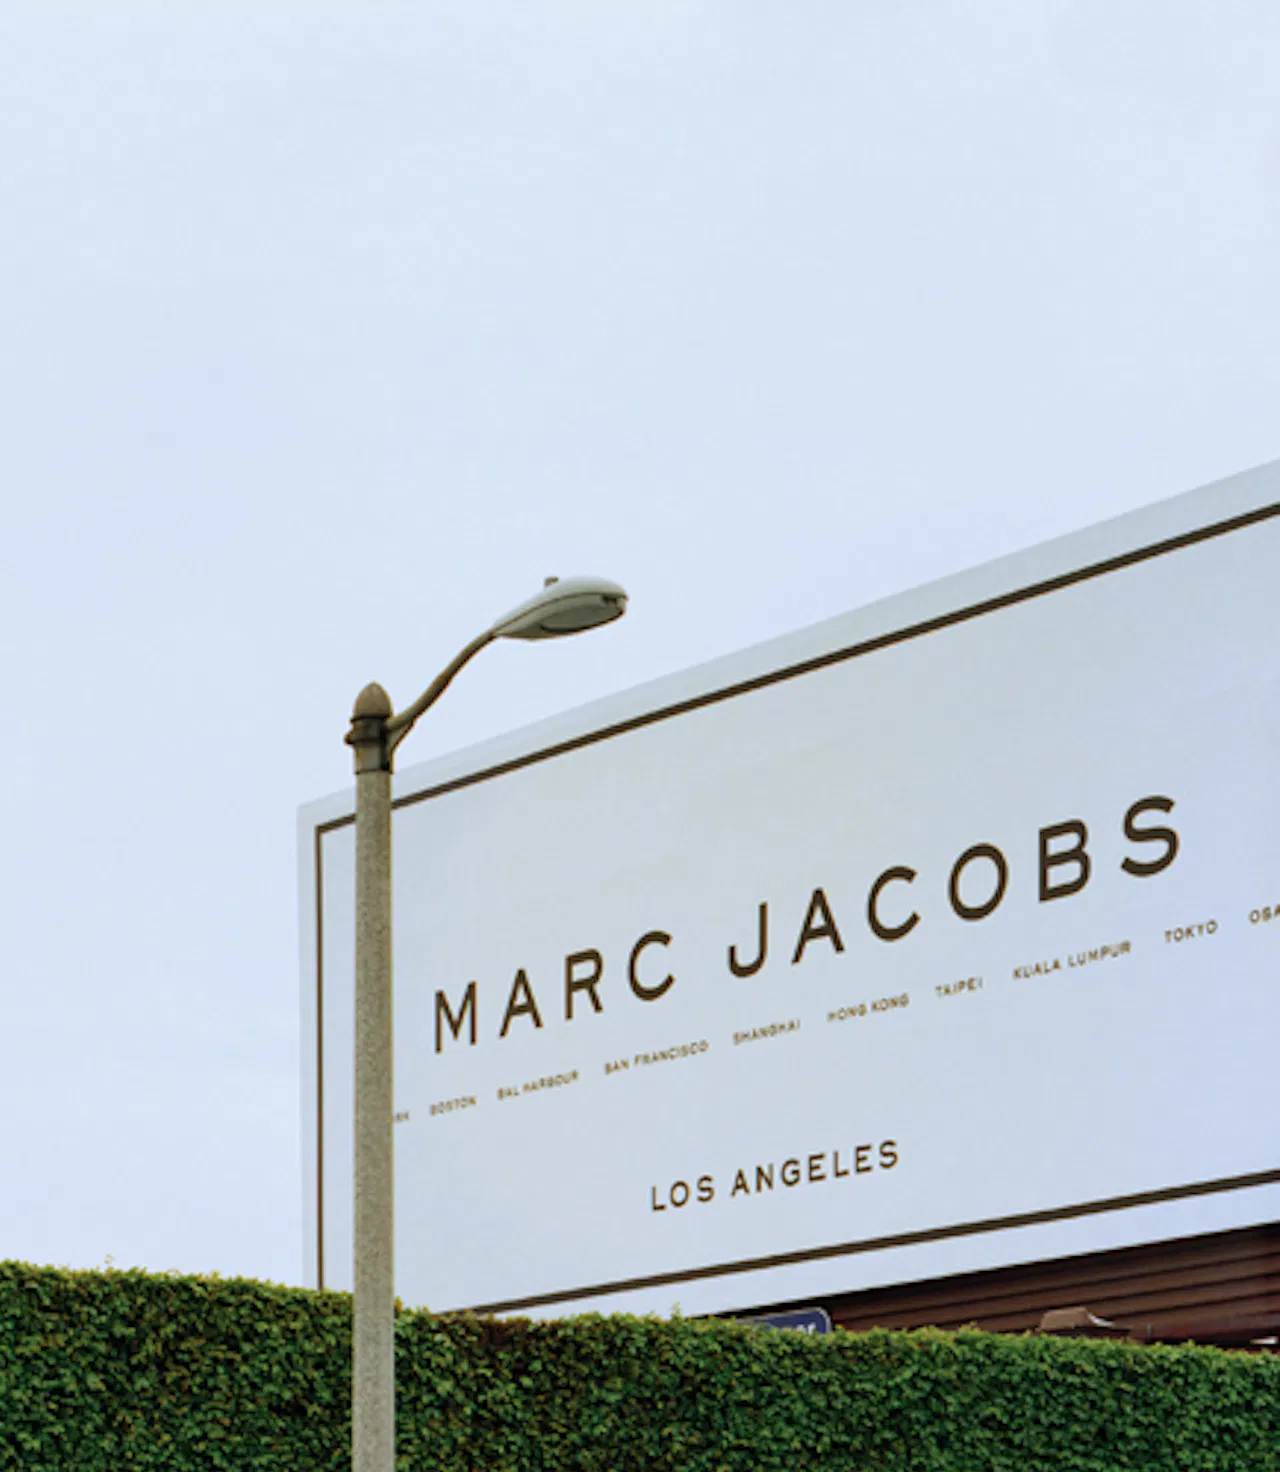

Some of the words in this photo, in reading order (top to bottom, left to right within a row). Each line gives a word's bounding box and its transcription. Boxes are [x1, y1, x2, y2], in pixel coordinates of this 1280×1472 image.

[429, 1096, 476, 1116] BOSTON
[522, 1069, 579, 1092] HARBOUR
[604, 1059, 629, 1075] SAN
[634, 1039, 709, 1066] FRANCISCO
[732, 1020, 800, 1046] SHANGHAI
[827, 1003, 868, 1022] HONG
[871, 992, 909, 1012] KONG
[935, 977, 983, 998] TAIPEI
[1012, 958, 1062, 980] KUALA
[1068, 940, 1132, 968] LUMPUR
[1164, 919, 1218, 943] TOKYO
[435, 930, 675, 1054] MARC
[728, 795, 1179, 978] JACOBS
[650, 1174, 716, 1211] LOS
[729, 1139, 900, 1197] ANGELES
